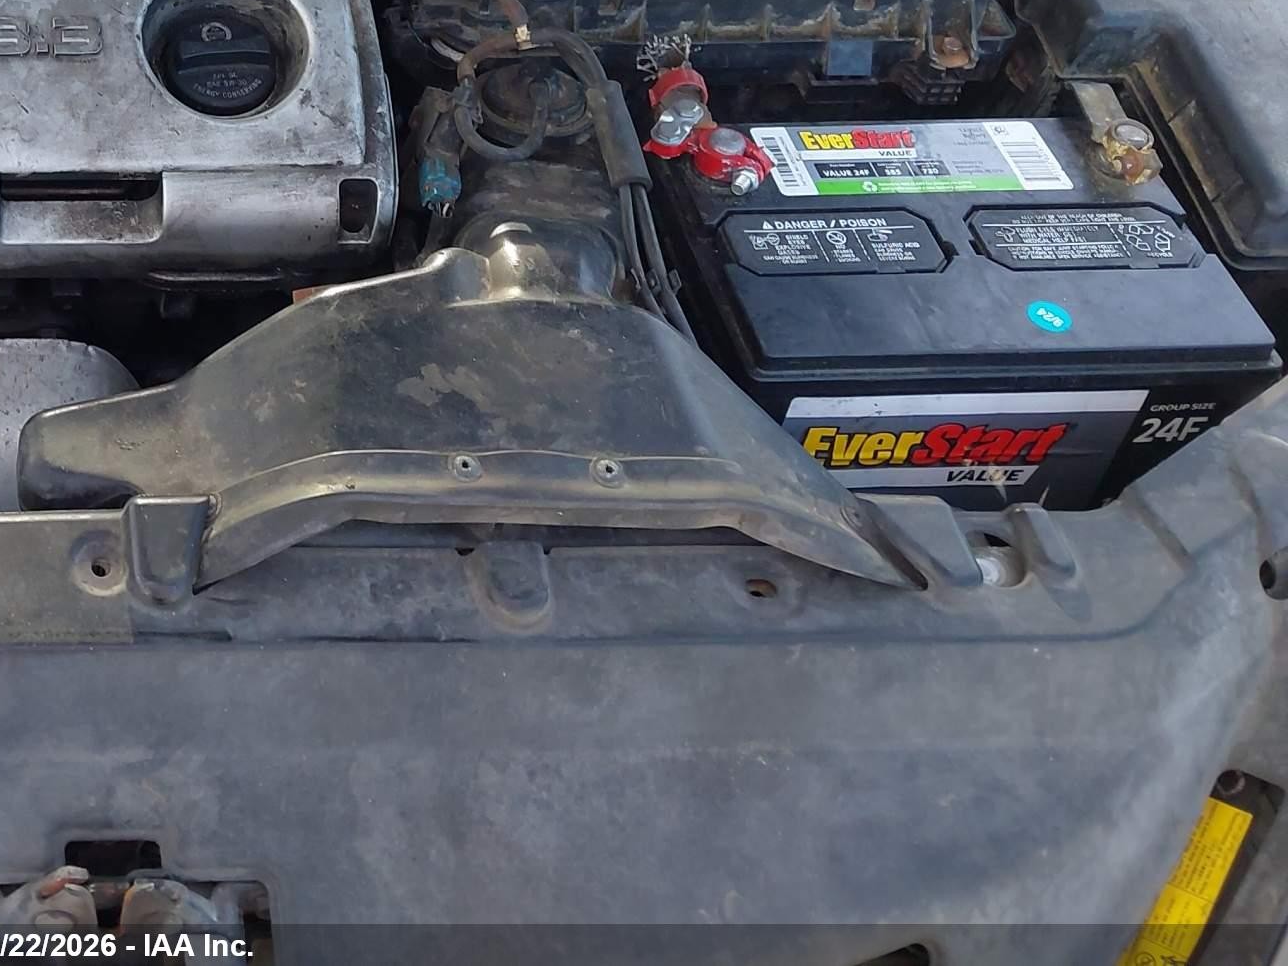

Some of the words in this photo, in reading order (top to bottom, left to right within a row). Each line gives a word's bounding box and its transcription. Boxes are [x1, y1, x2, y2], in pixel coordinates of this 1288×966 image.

[799, 129, 916, 151] EverStart
[823, 169, 853, 177] VALUE
[774, 220, 828, 229] DANGER
[838, 218, 888, 227] POISON
[1150, 403, 1190, 411] GROUP
[1191, 402, 1217, 410] SIZE
[1132, 416, 1209, 443] 24F
[803, 421, 1069, 467] EverStart
